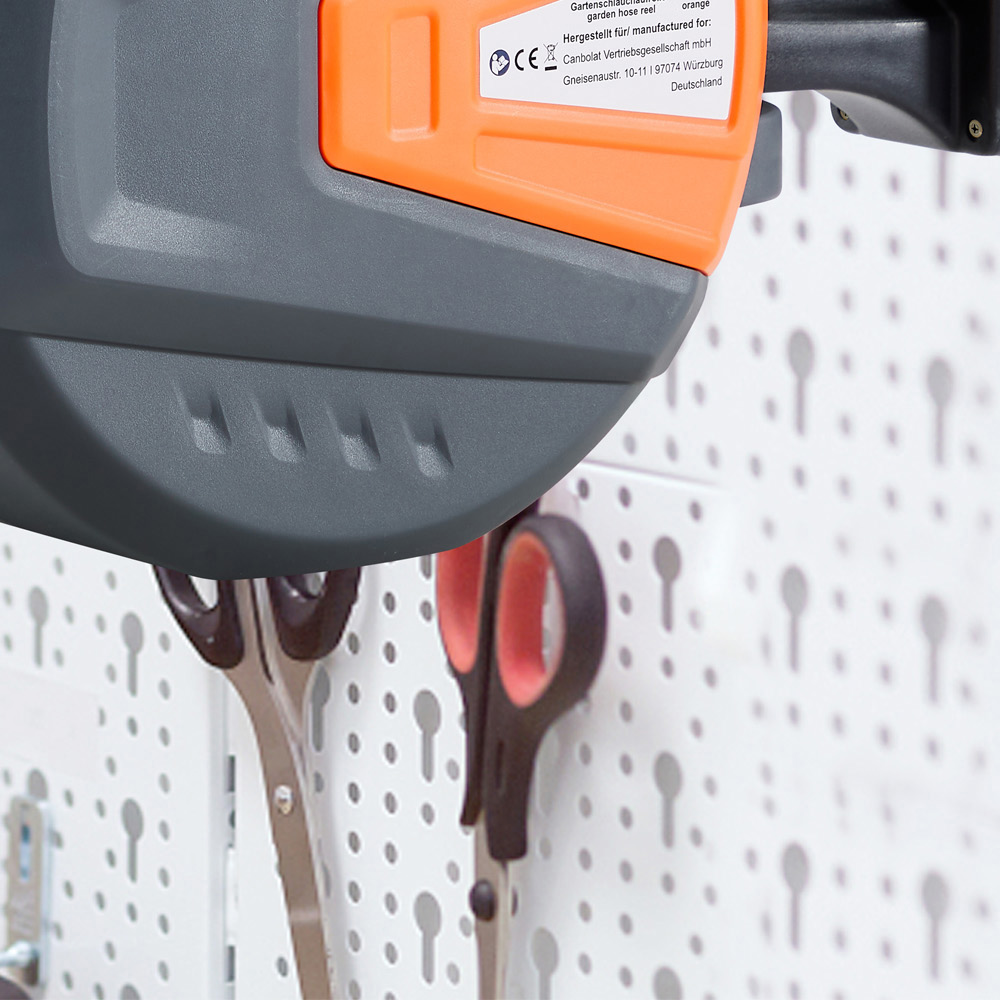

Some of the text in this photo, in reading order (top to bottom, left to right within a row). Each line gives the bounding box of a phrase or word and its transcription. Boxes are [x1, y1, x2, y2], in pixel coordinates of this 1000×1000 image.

[587, 0, 710, 23] garden hose reel orange
[563, 18, 712, 44] Hergestellt für/ manufactured for:
[563, 38, 712, 65] Canbolat Vertriebsgesellschaft mbH
[563, 71, 621, 86] Gneisenaustr.
[625, 67, 647, 78] 10-11
[655, 62, 681, 75] 97074
[683, 58, 723, 72] Würzburg
[671, 77, 723, 92] Deutschland
